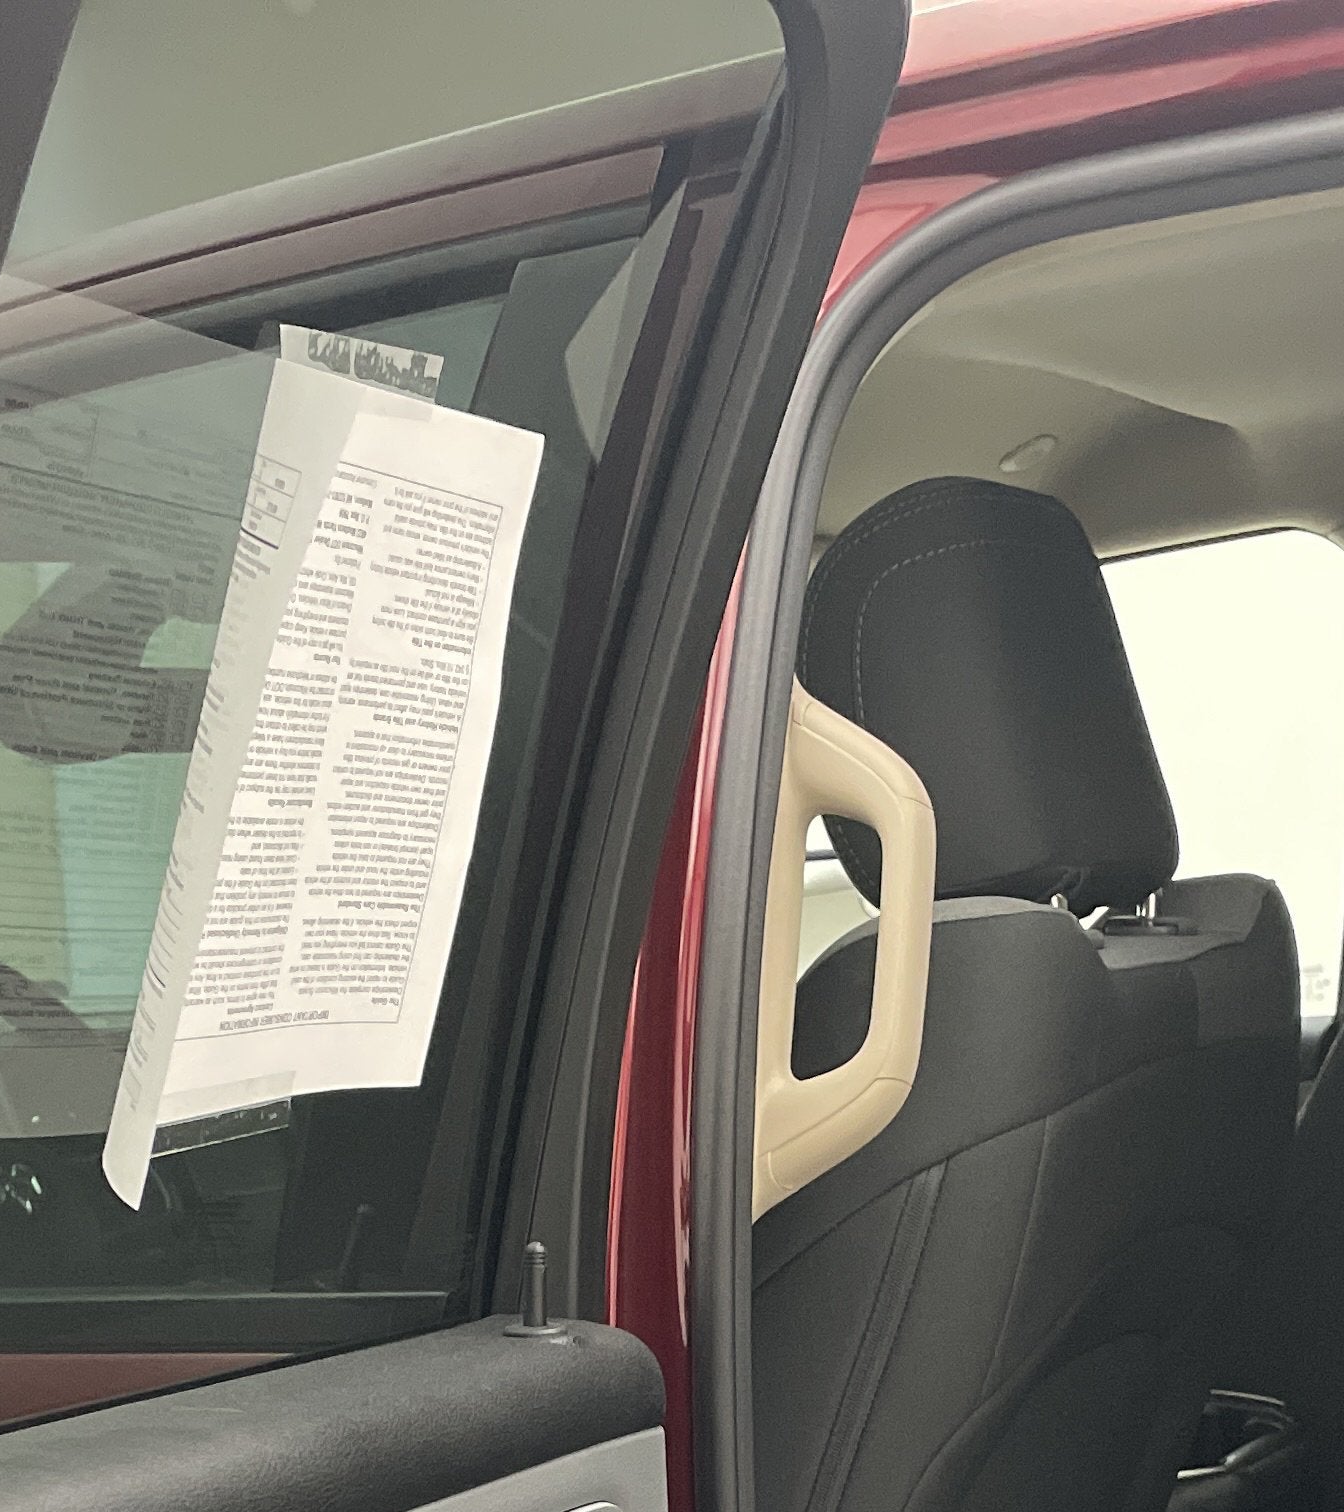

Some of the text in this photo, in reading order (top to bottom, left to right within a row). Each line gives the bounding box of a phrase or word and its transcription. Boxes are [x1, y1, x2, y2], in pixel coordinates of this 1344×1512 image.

[404, 718, 415, 726] and
[416, 718, 438, 729] History
[219, 1010, 329, 1030] IMPORTANT CONSUMER INFORMATION
